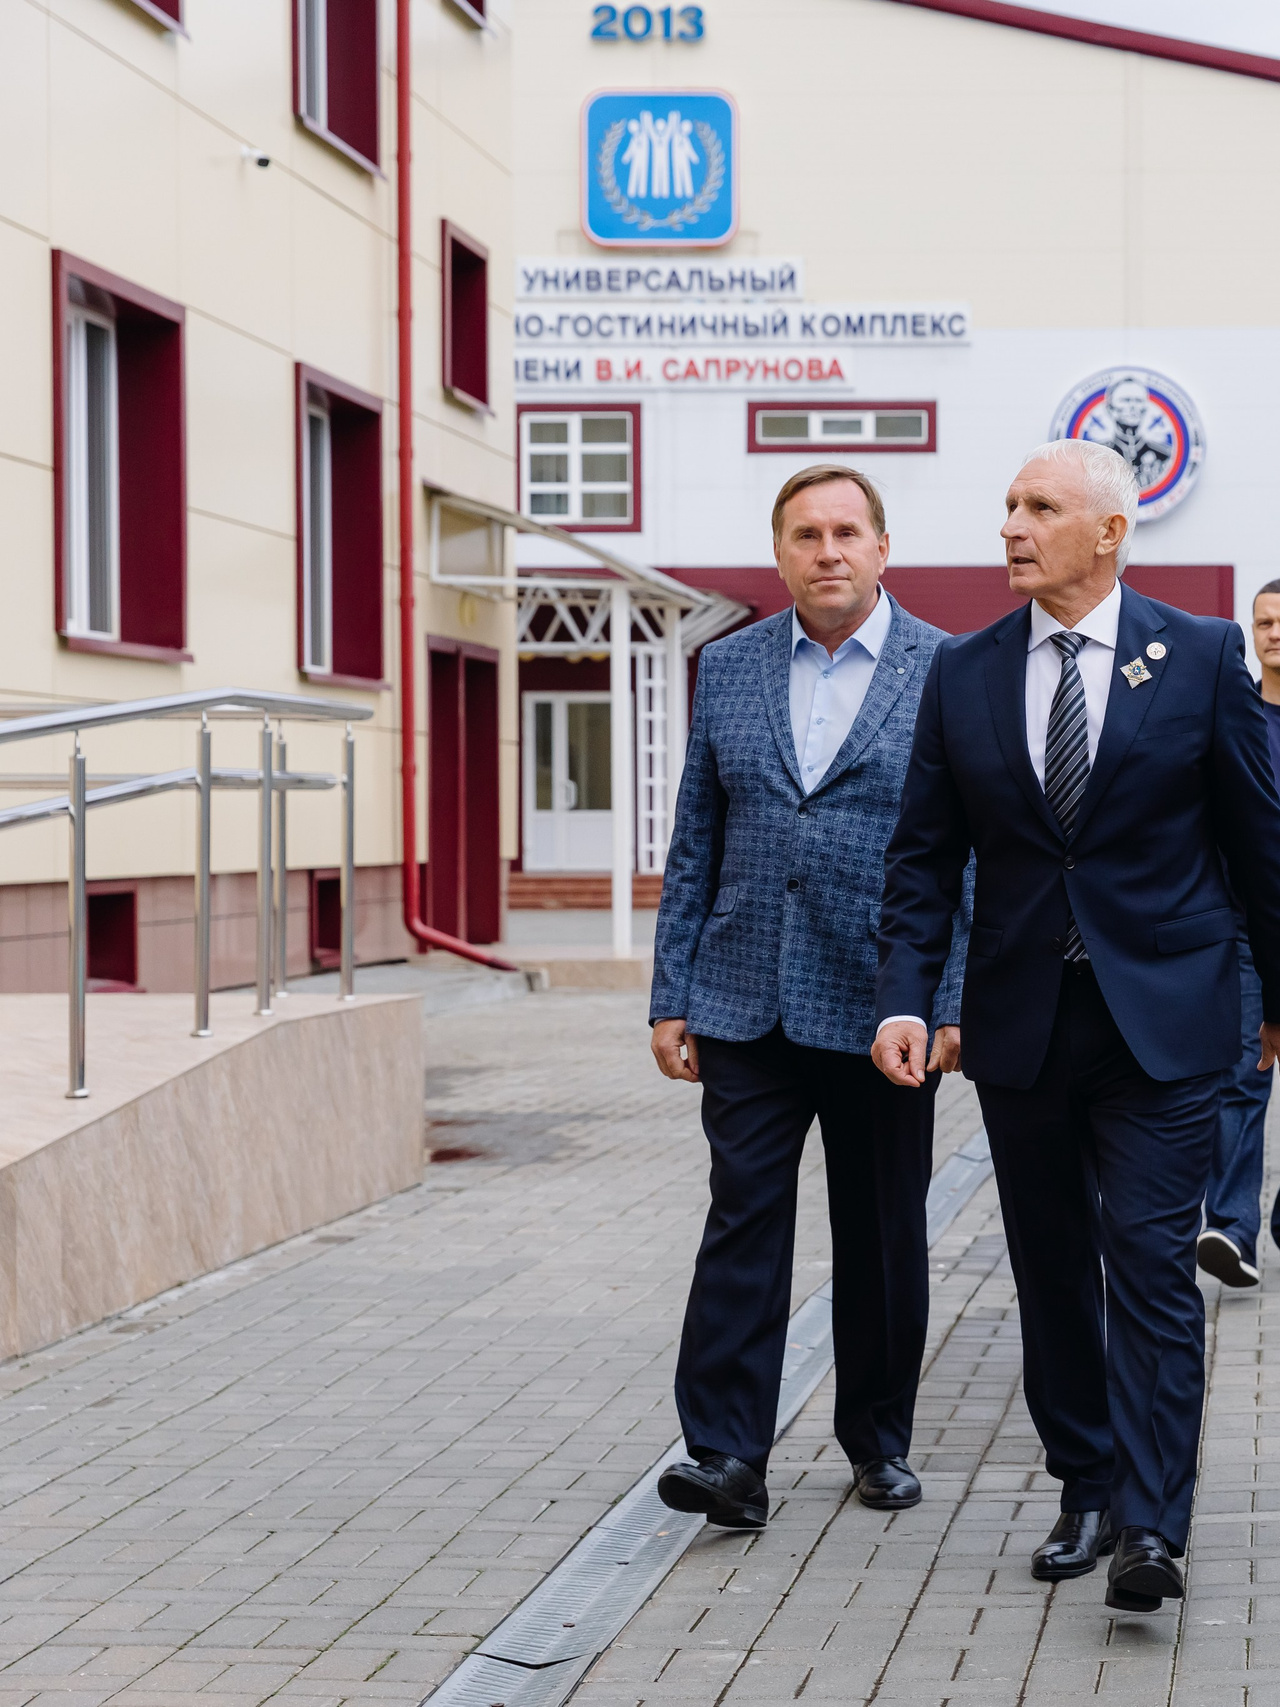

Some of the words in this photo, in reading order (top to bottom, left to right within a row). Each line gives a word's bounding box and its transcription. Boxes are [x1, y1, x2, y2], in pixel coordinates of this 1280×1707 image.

[590, 5, 704, 41] 2013
[523, 264, 797, 292] УНИВЕРСАЛЬНЫЙ
[802, 313, 967, 337] КОМПЛЕКС
[515, 358, 582, 382] ЕНИ
[595, 358, 652, 382] В.И.
[661, 358, 846, 382] САПРУНОВА
